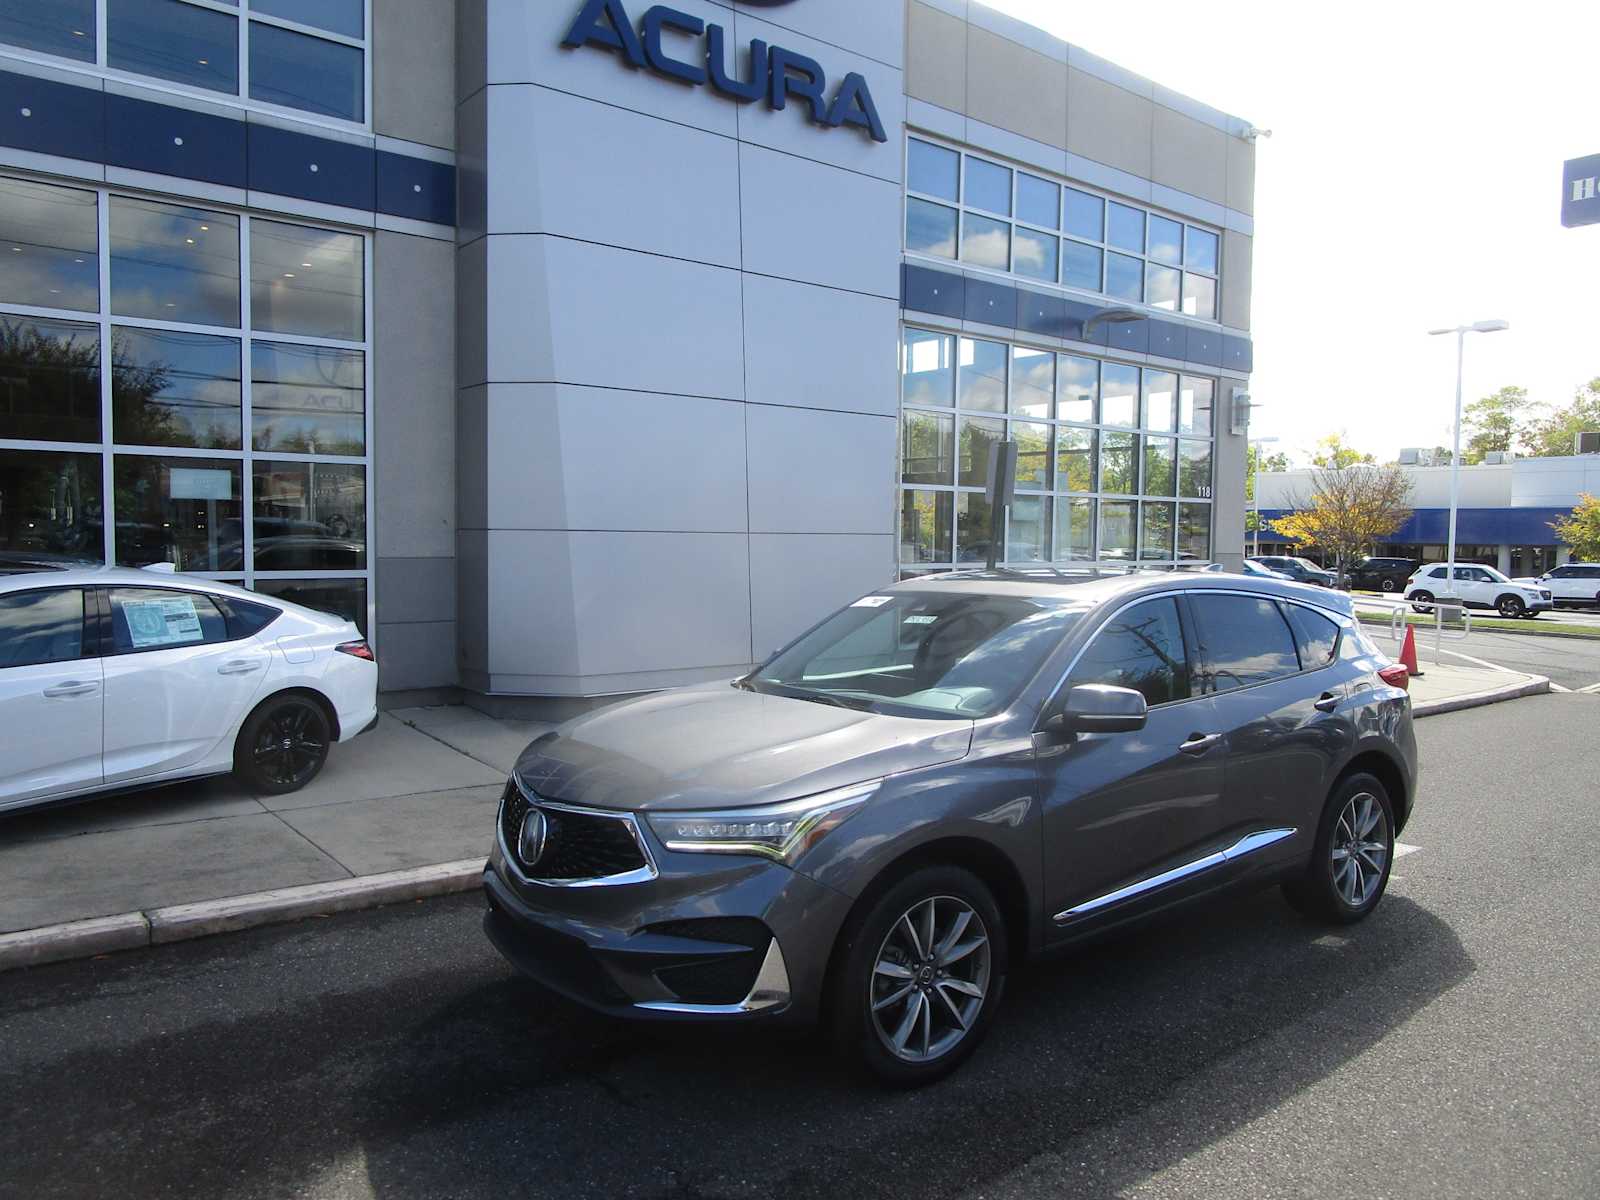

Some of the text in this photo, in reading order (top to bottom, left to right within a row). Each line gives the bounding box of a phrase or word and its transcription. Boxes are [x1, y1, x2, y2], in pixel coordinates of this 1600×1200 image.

[560, 0, 887, 143] ACURA
[1569, 176, 1600, 202] H
[1197, 486, 1211, 498] 118
